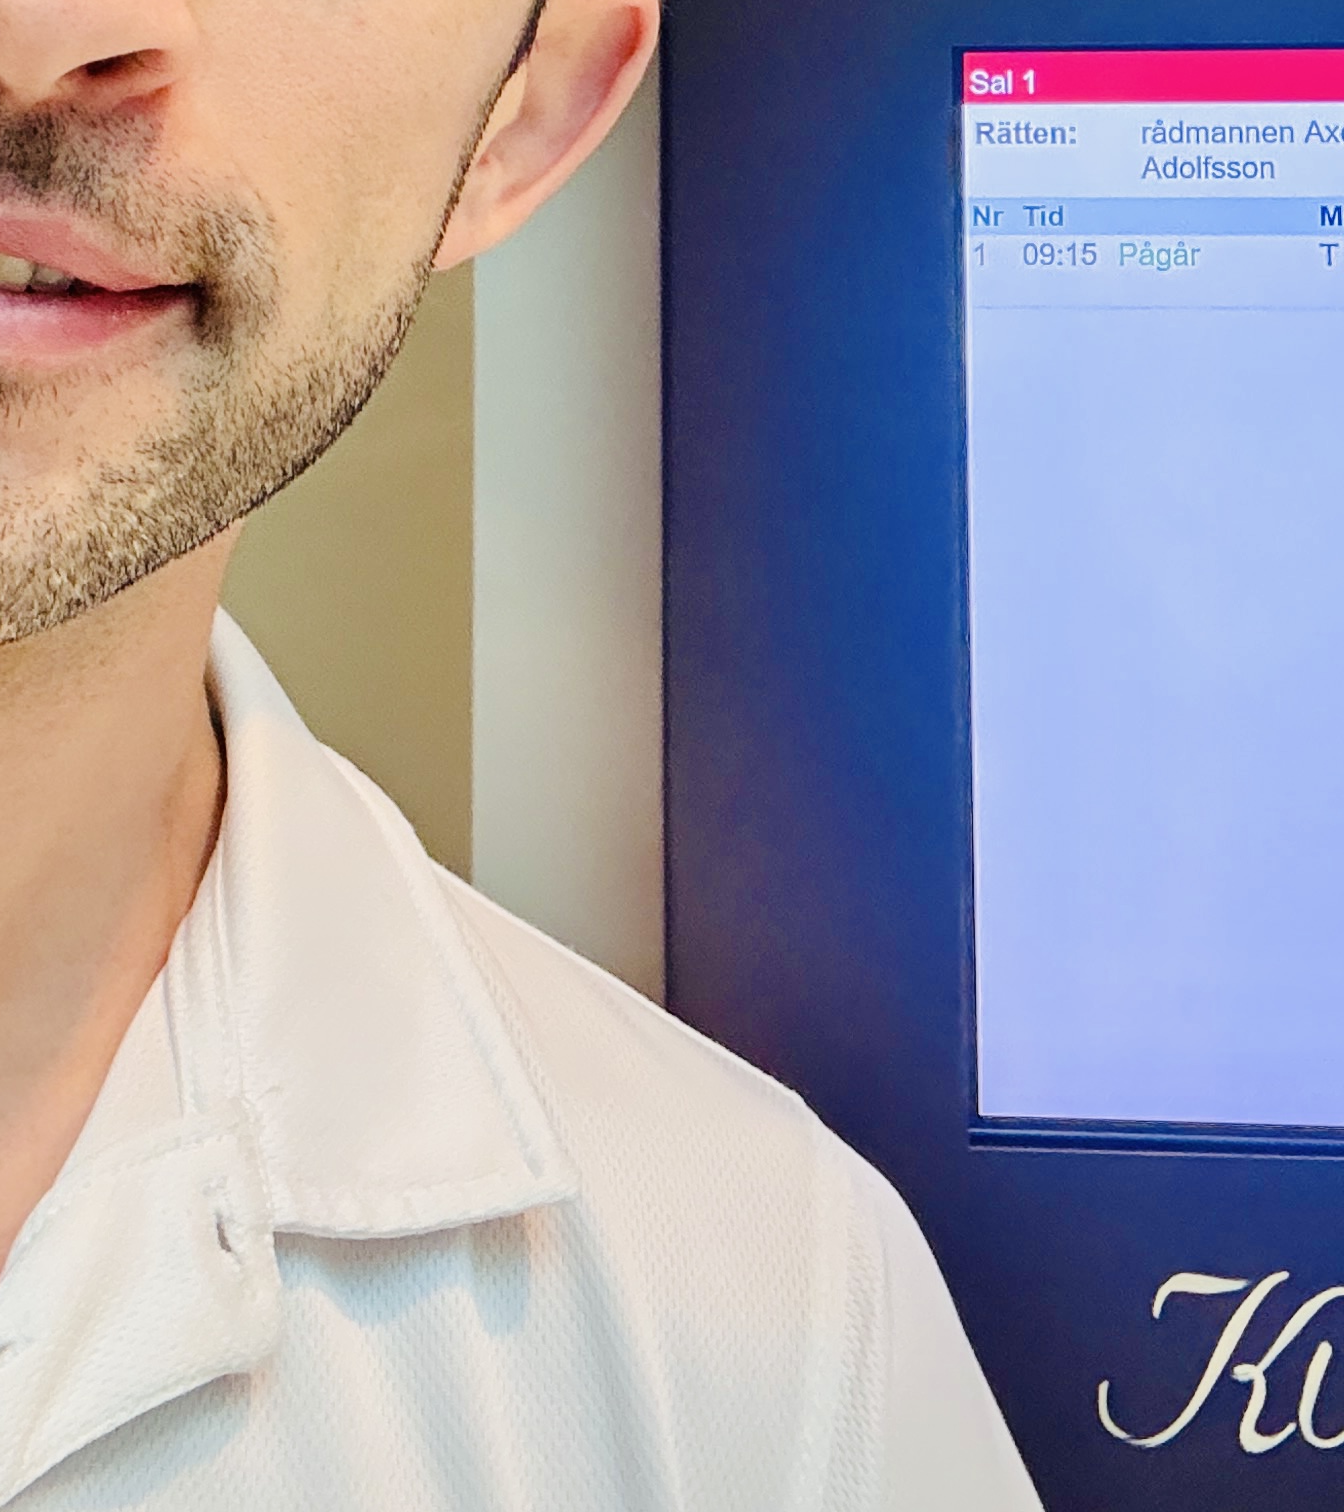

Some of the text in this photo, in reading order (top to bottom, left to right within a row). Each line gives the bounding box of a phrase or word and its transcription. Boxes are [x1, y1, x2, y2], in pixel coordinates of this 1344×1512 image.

[968, 68, 1035, 95] Sal 1
[977, 121, 1077, 145] Rätten:
[1142, 119, 1295, 145] rådmannen
[1141, 155, 1275, 179] Adolfsson
[973, 205, 1005, 227] Nr
[1022, 204, 1064, 227] Tid
[974, 242, 985, 267] 1
[1023, 242, 1097, 267] 09:15
[1119, 240, 1201, 272] Pågår
[1319, 243, 1339, 267] T
